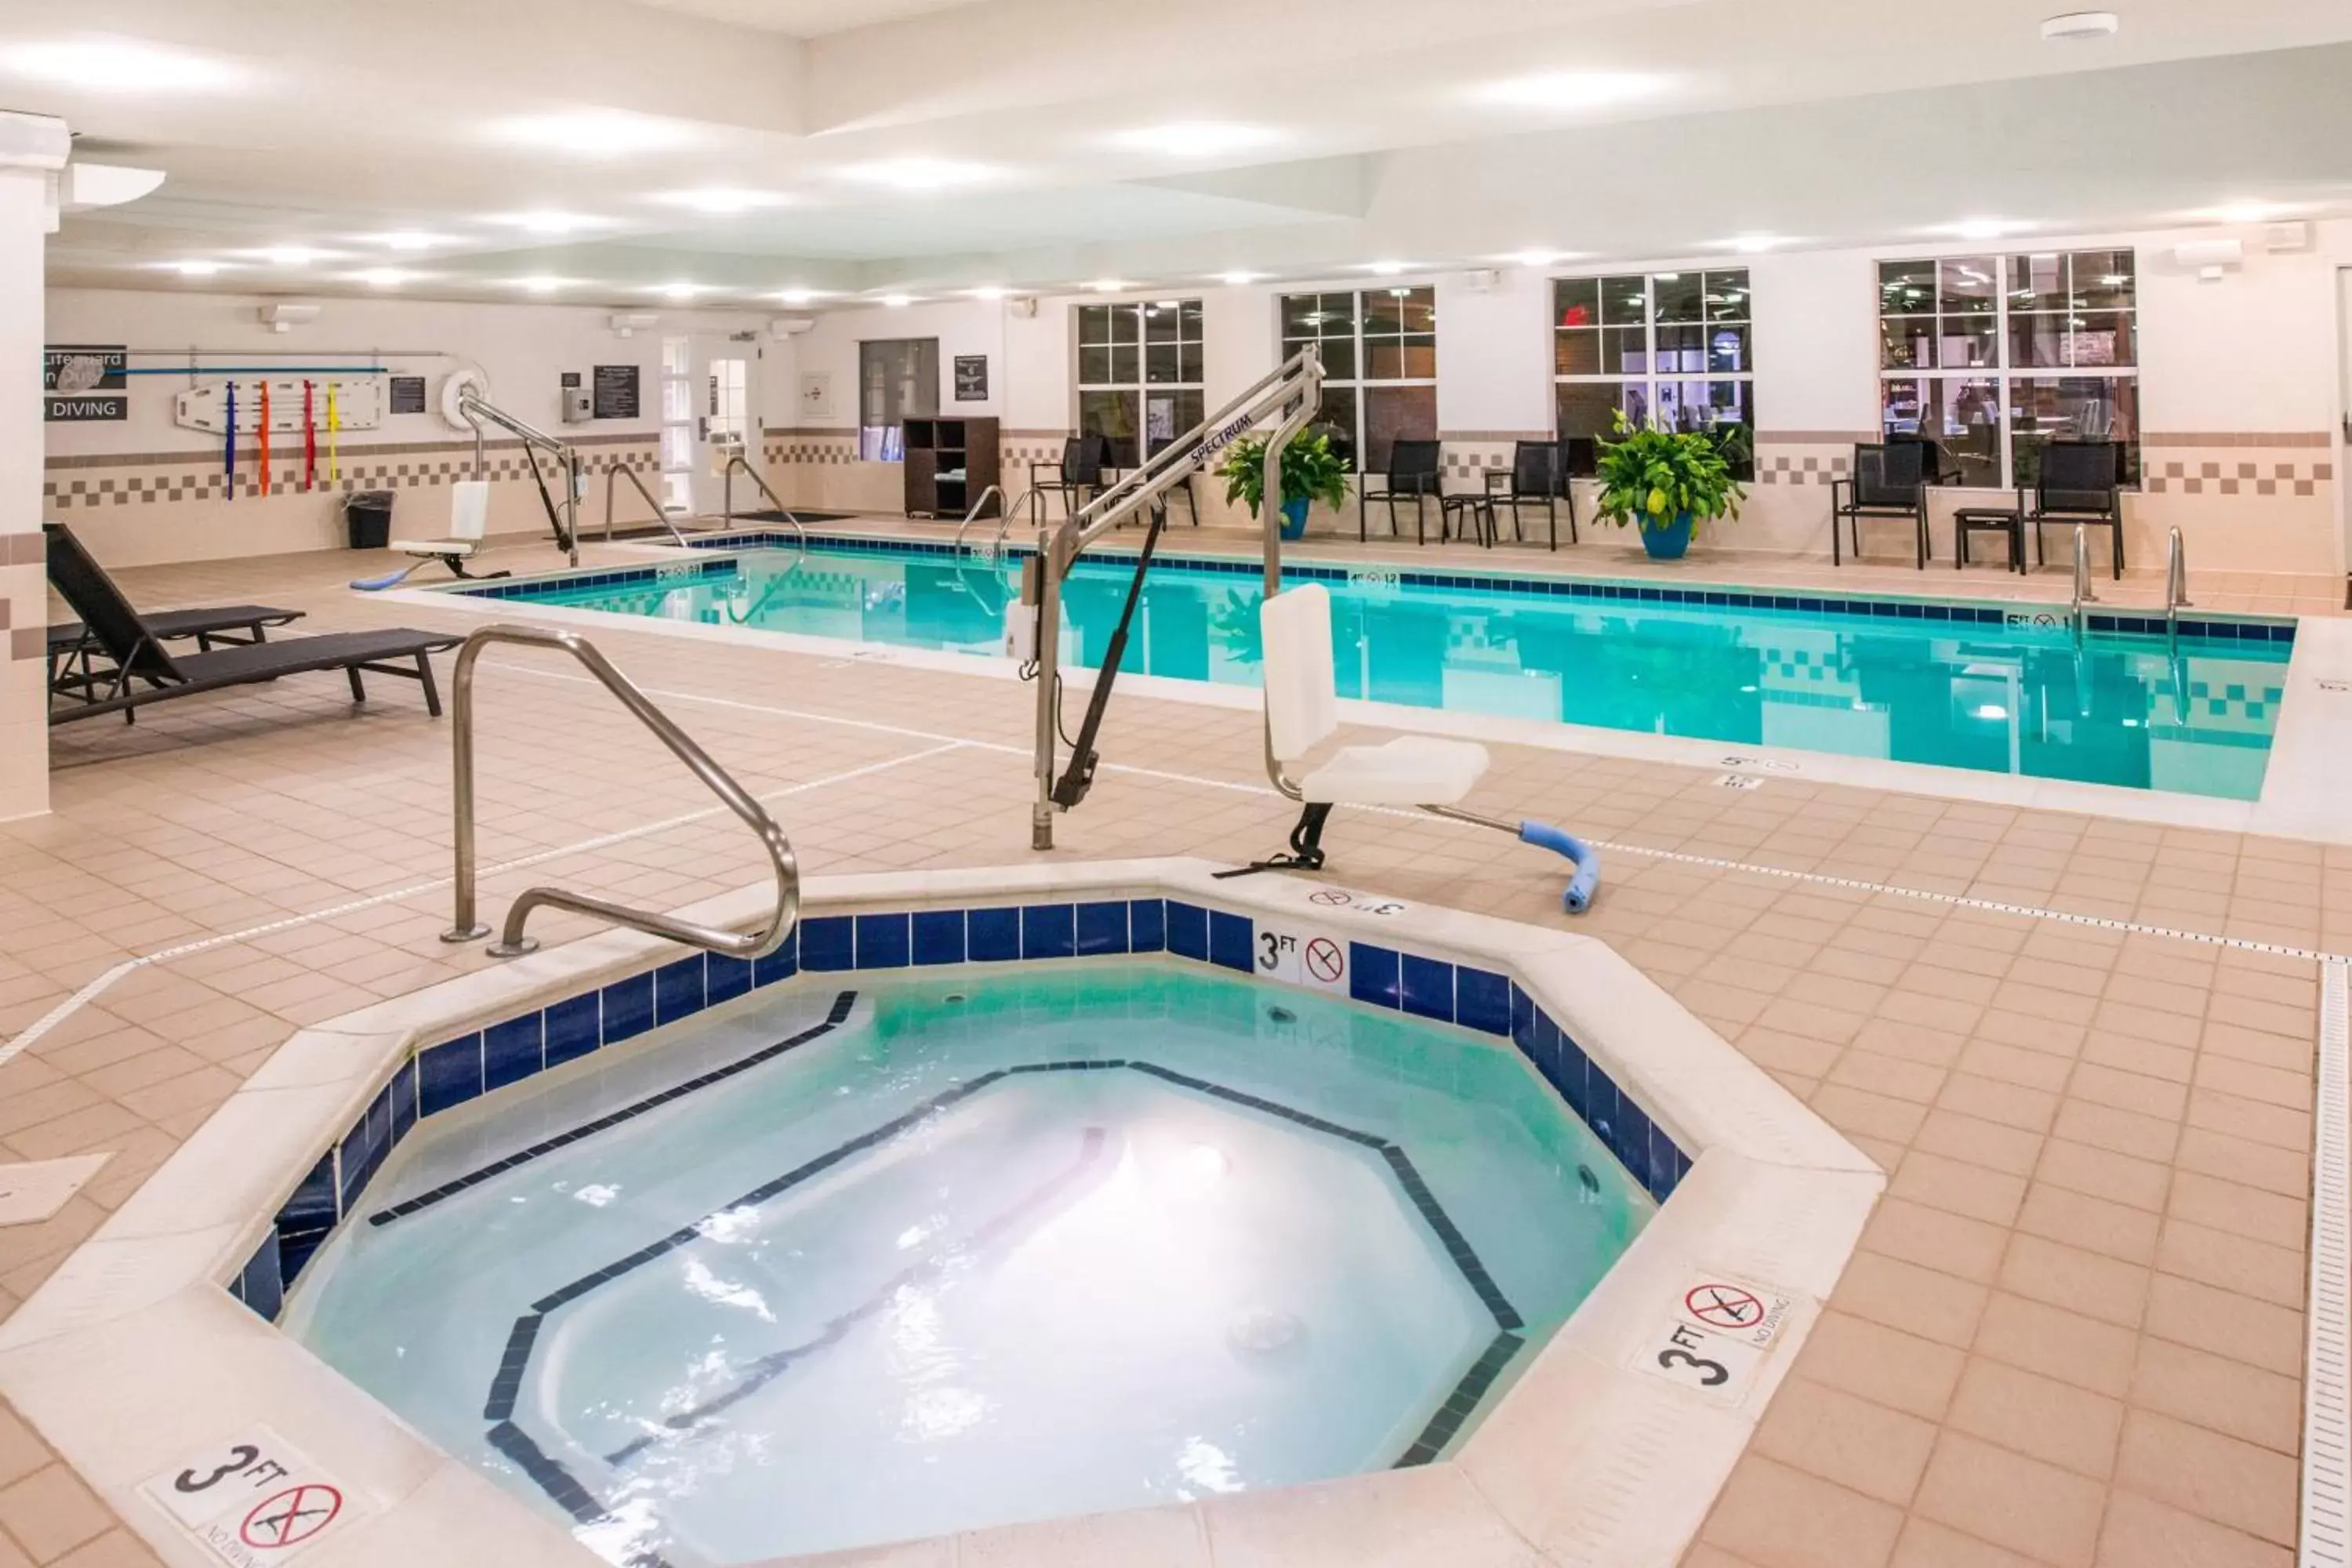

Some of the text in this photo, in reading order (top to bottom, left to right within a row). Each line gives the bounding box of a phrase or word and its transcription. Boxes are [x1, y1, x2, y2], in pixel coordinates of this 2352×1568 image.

[45, 372, 56, 383] n
[53, 401, 117, 416] DIVING
[1191, 414, 1253, 463] SPECTRUM
